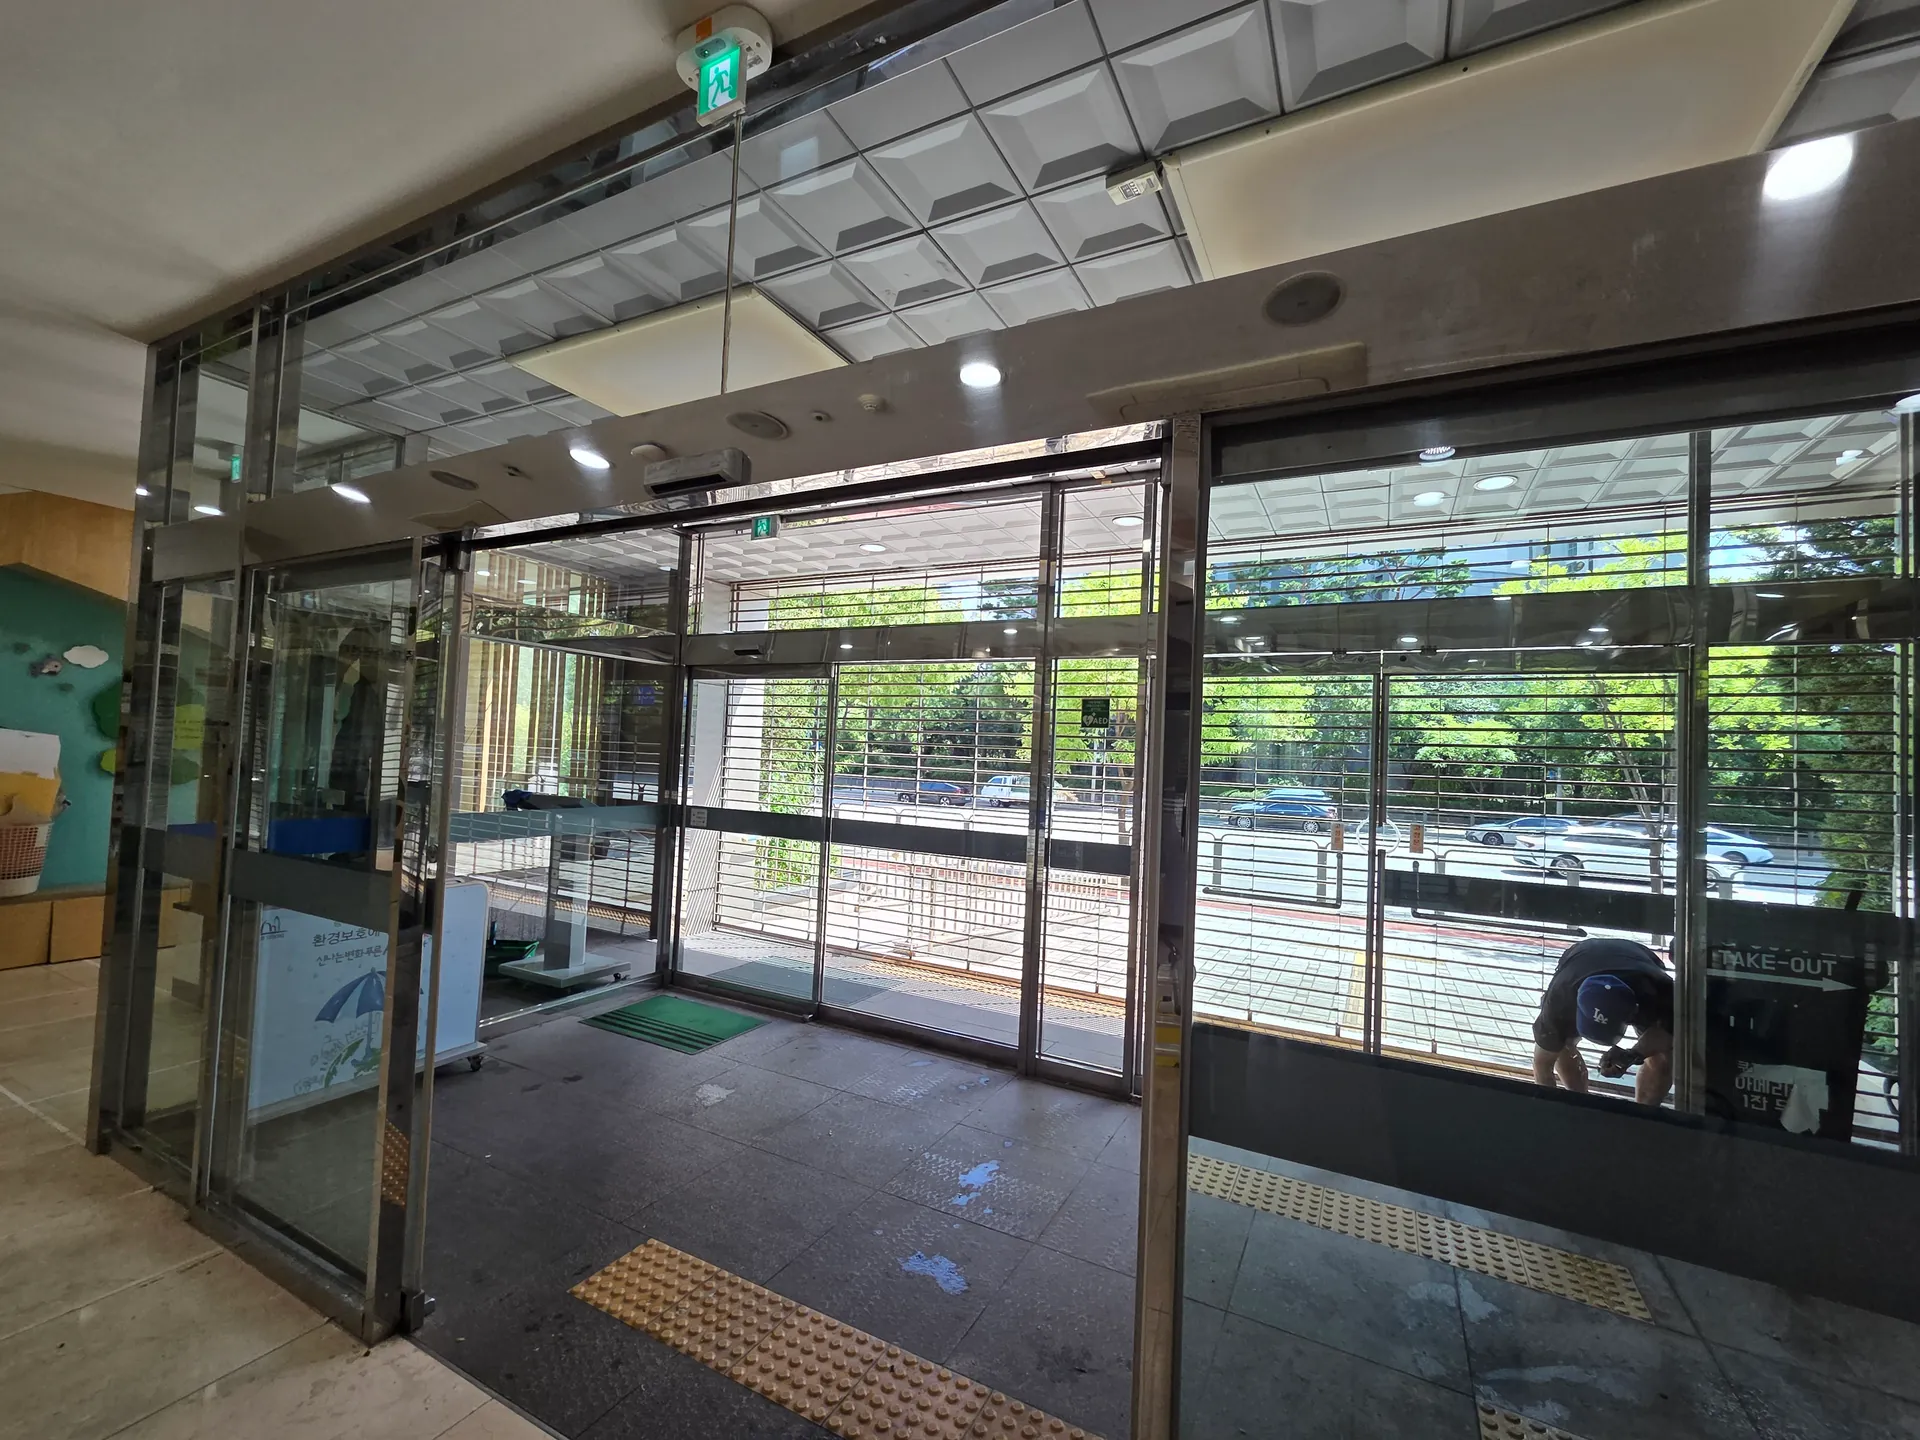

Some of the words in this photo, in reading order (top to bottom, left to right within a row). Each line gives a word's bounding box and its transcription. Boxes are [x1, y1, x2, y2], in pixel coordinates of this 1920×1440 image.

[1093, 717, 1108, 725] AED
[1718, 949, 1837, 976] TAKE-OUT
[1593, 1007, 1608, 1024] LA
[1735, 1076, 1789, 1097] 아메리
[1743, 1094, 1768, 1111] 1잔
